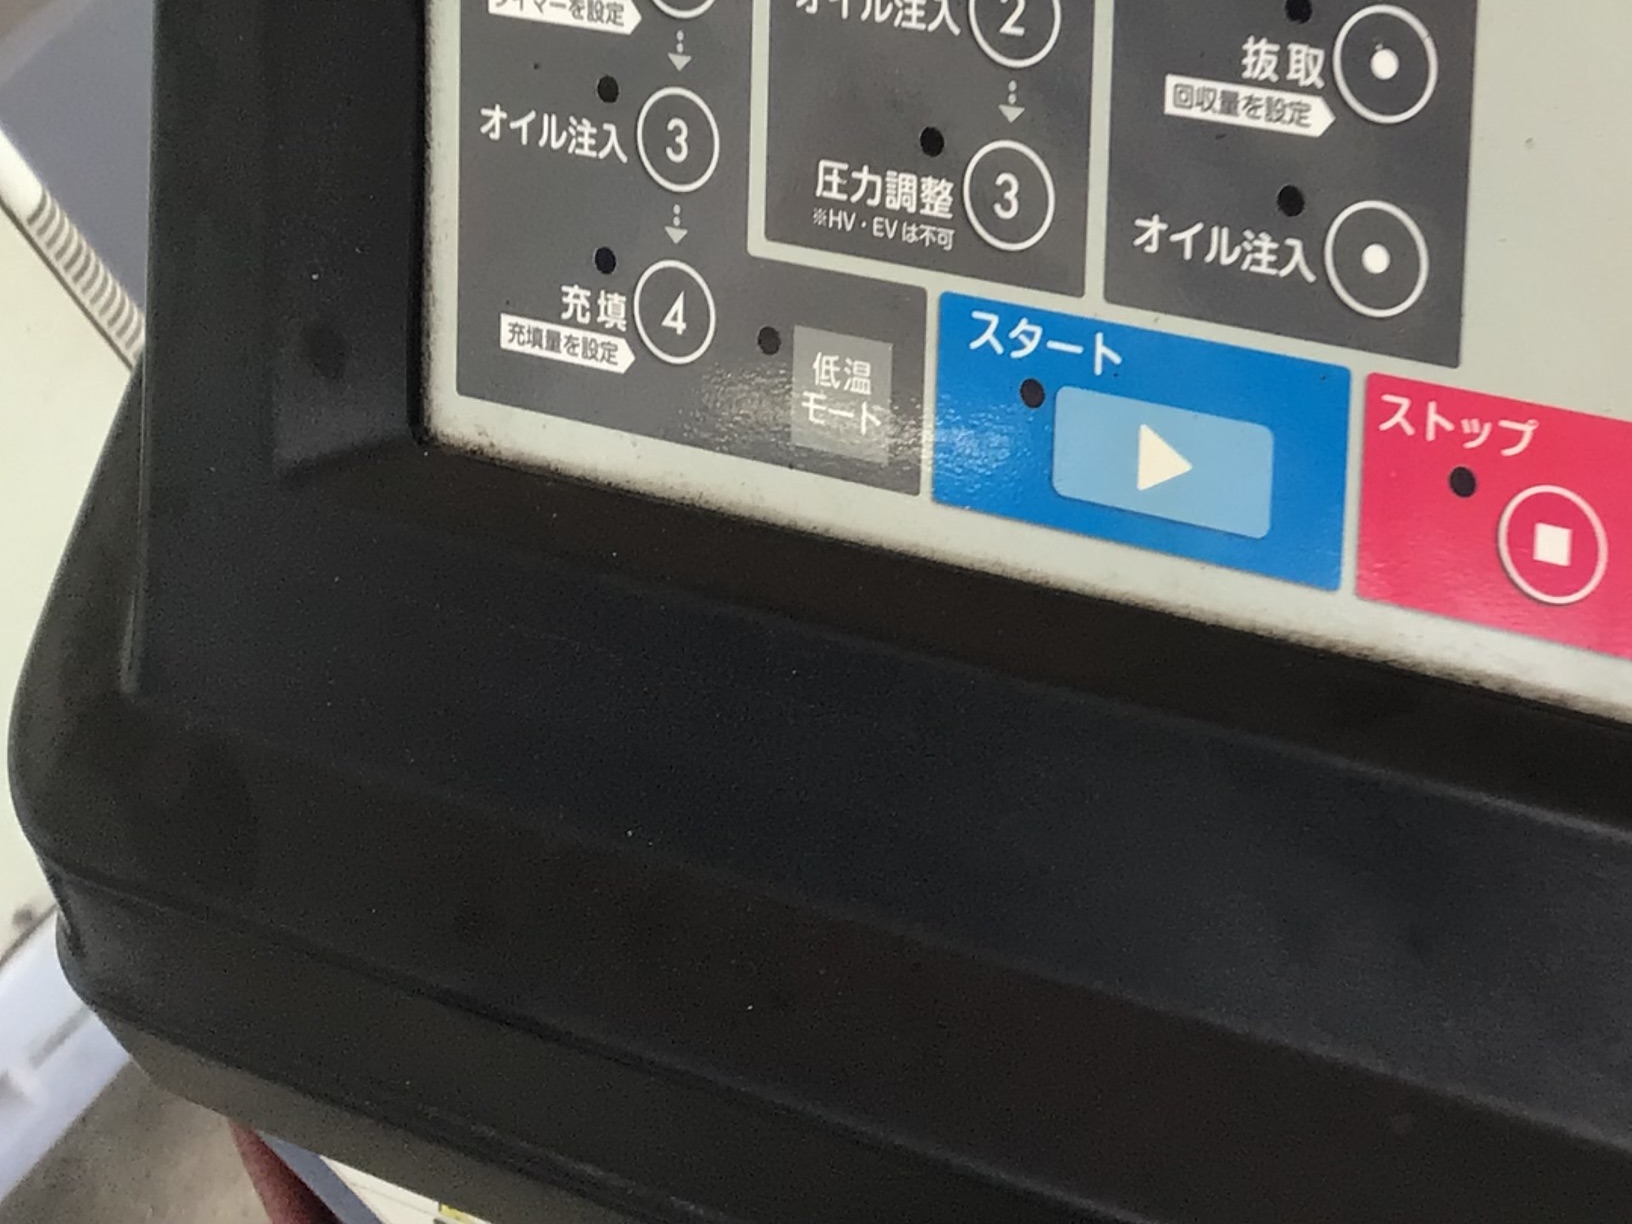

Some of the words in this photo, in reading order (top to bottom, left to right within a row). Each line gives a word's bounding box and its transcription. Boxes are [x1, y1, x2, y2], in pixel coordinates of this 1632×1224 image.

[1240, 34, 1327, 89] 抜取
[1172, 83, 1313, 130] 回収量を設定
[480, 103, 628, 164] オイル注入
[666, 117, 689, 163] 3
[815, 158, 955, 221] 圧力調整
[993, 172, 1019, 220] 3
[1132, 213, 1318, 284] オイル注入
[560, 284, 628, 333] 充填
[661, 291, 688, 335] 4
[507, 321, 620, 366] 充填量を設定
[969, 311, 1123, 376] スタート
[812, 351, 873, 396] 低温
[1378, 393, 1539, 457] ストップ
